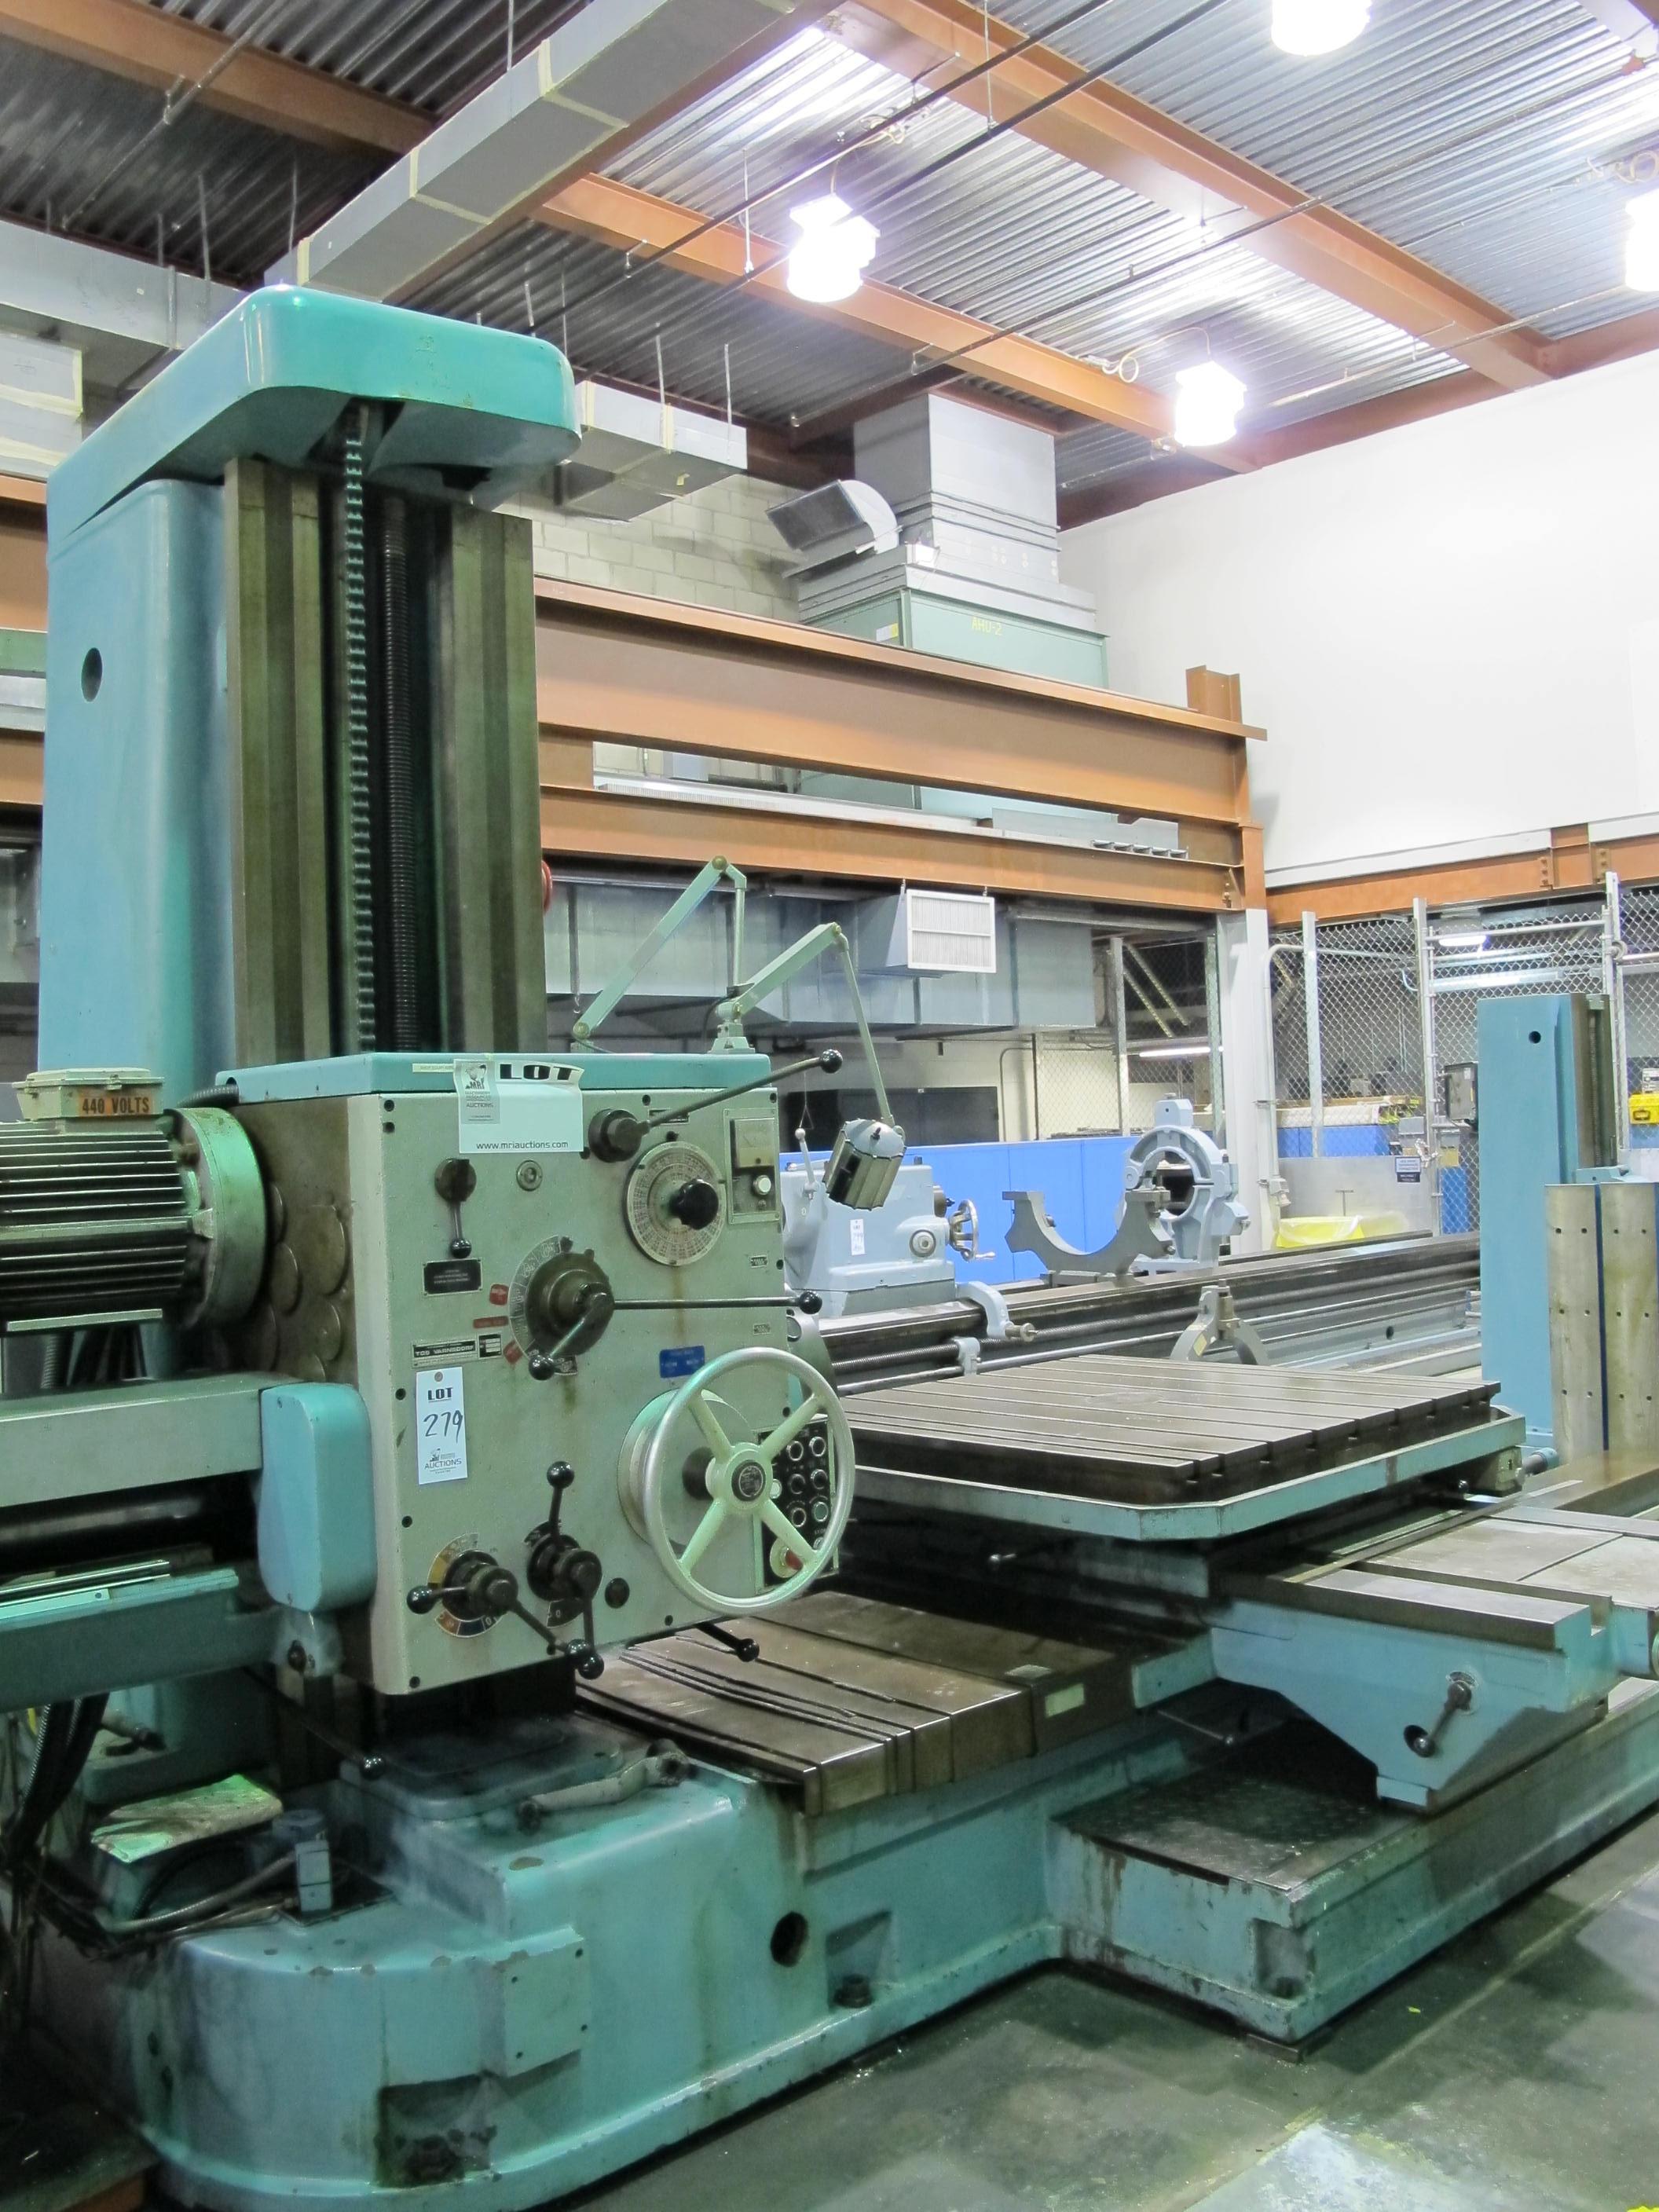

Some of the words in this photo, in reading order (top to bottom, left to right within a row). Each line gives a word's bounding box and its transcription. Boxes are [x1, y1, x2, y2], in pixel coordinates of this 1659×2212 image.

[972, 617, 1002, 635] AHU-2
[500, 1064, 580, 1080] LOT
[82, 1098, 105, 1114] 440
[111, 1097, 150, 1113] VOLTS
[476, 1141, 569, 1149] www.mriauctions.com
[427, 1387, 454, 1401] LOT
[423, 1410, 463, 1443] 279
[424, 1458, 462, 1469] AUCTIONS
